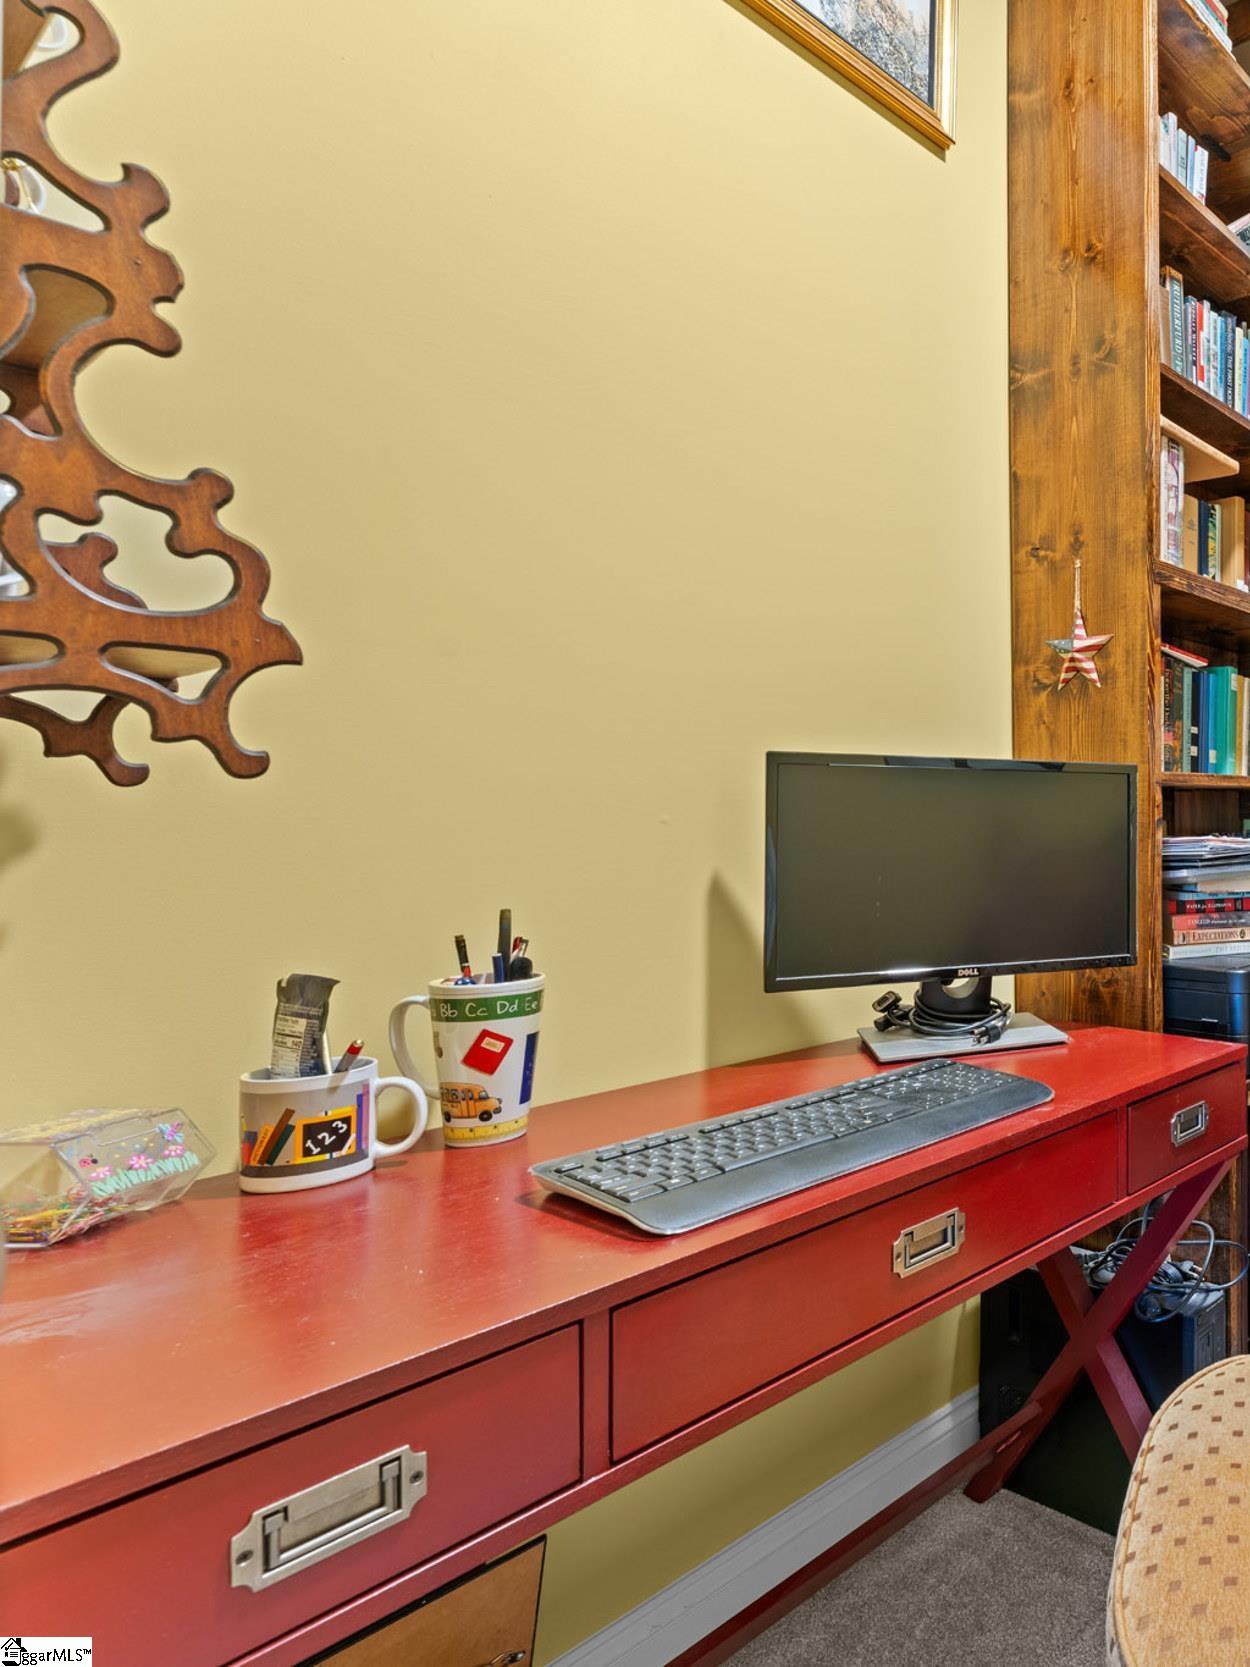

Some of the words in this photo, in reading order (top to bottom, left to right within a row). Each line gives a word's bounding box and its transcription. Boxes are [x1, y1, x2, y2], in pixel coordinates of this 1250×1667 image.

[1172, 283, 1183, 353] RUTHERFURD
[958, 967, 979, 976] DELL
[440, 1003, 457, 1018] Bb
[465, 1000, 488, 1017] Cc
[496, 998, 518, 1014] Dd
[524, 997, 539, 1012] Ee
[305, 1139, 320, 1155] 1
[317, 1127, 336, 1145] 2
[332, 1119, 348, 1134] 3
